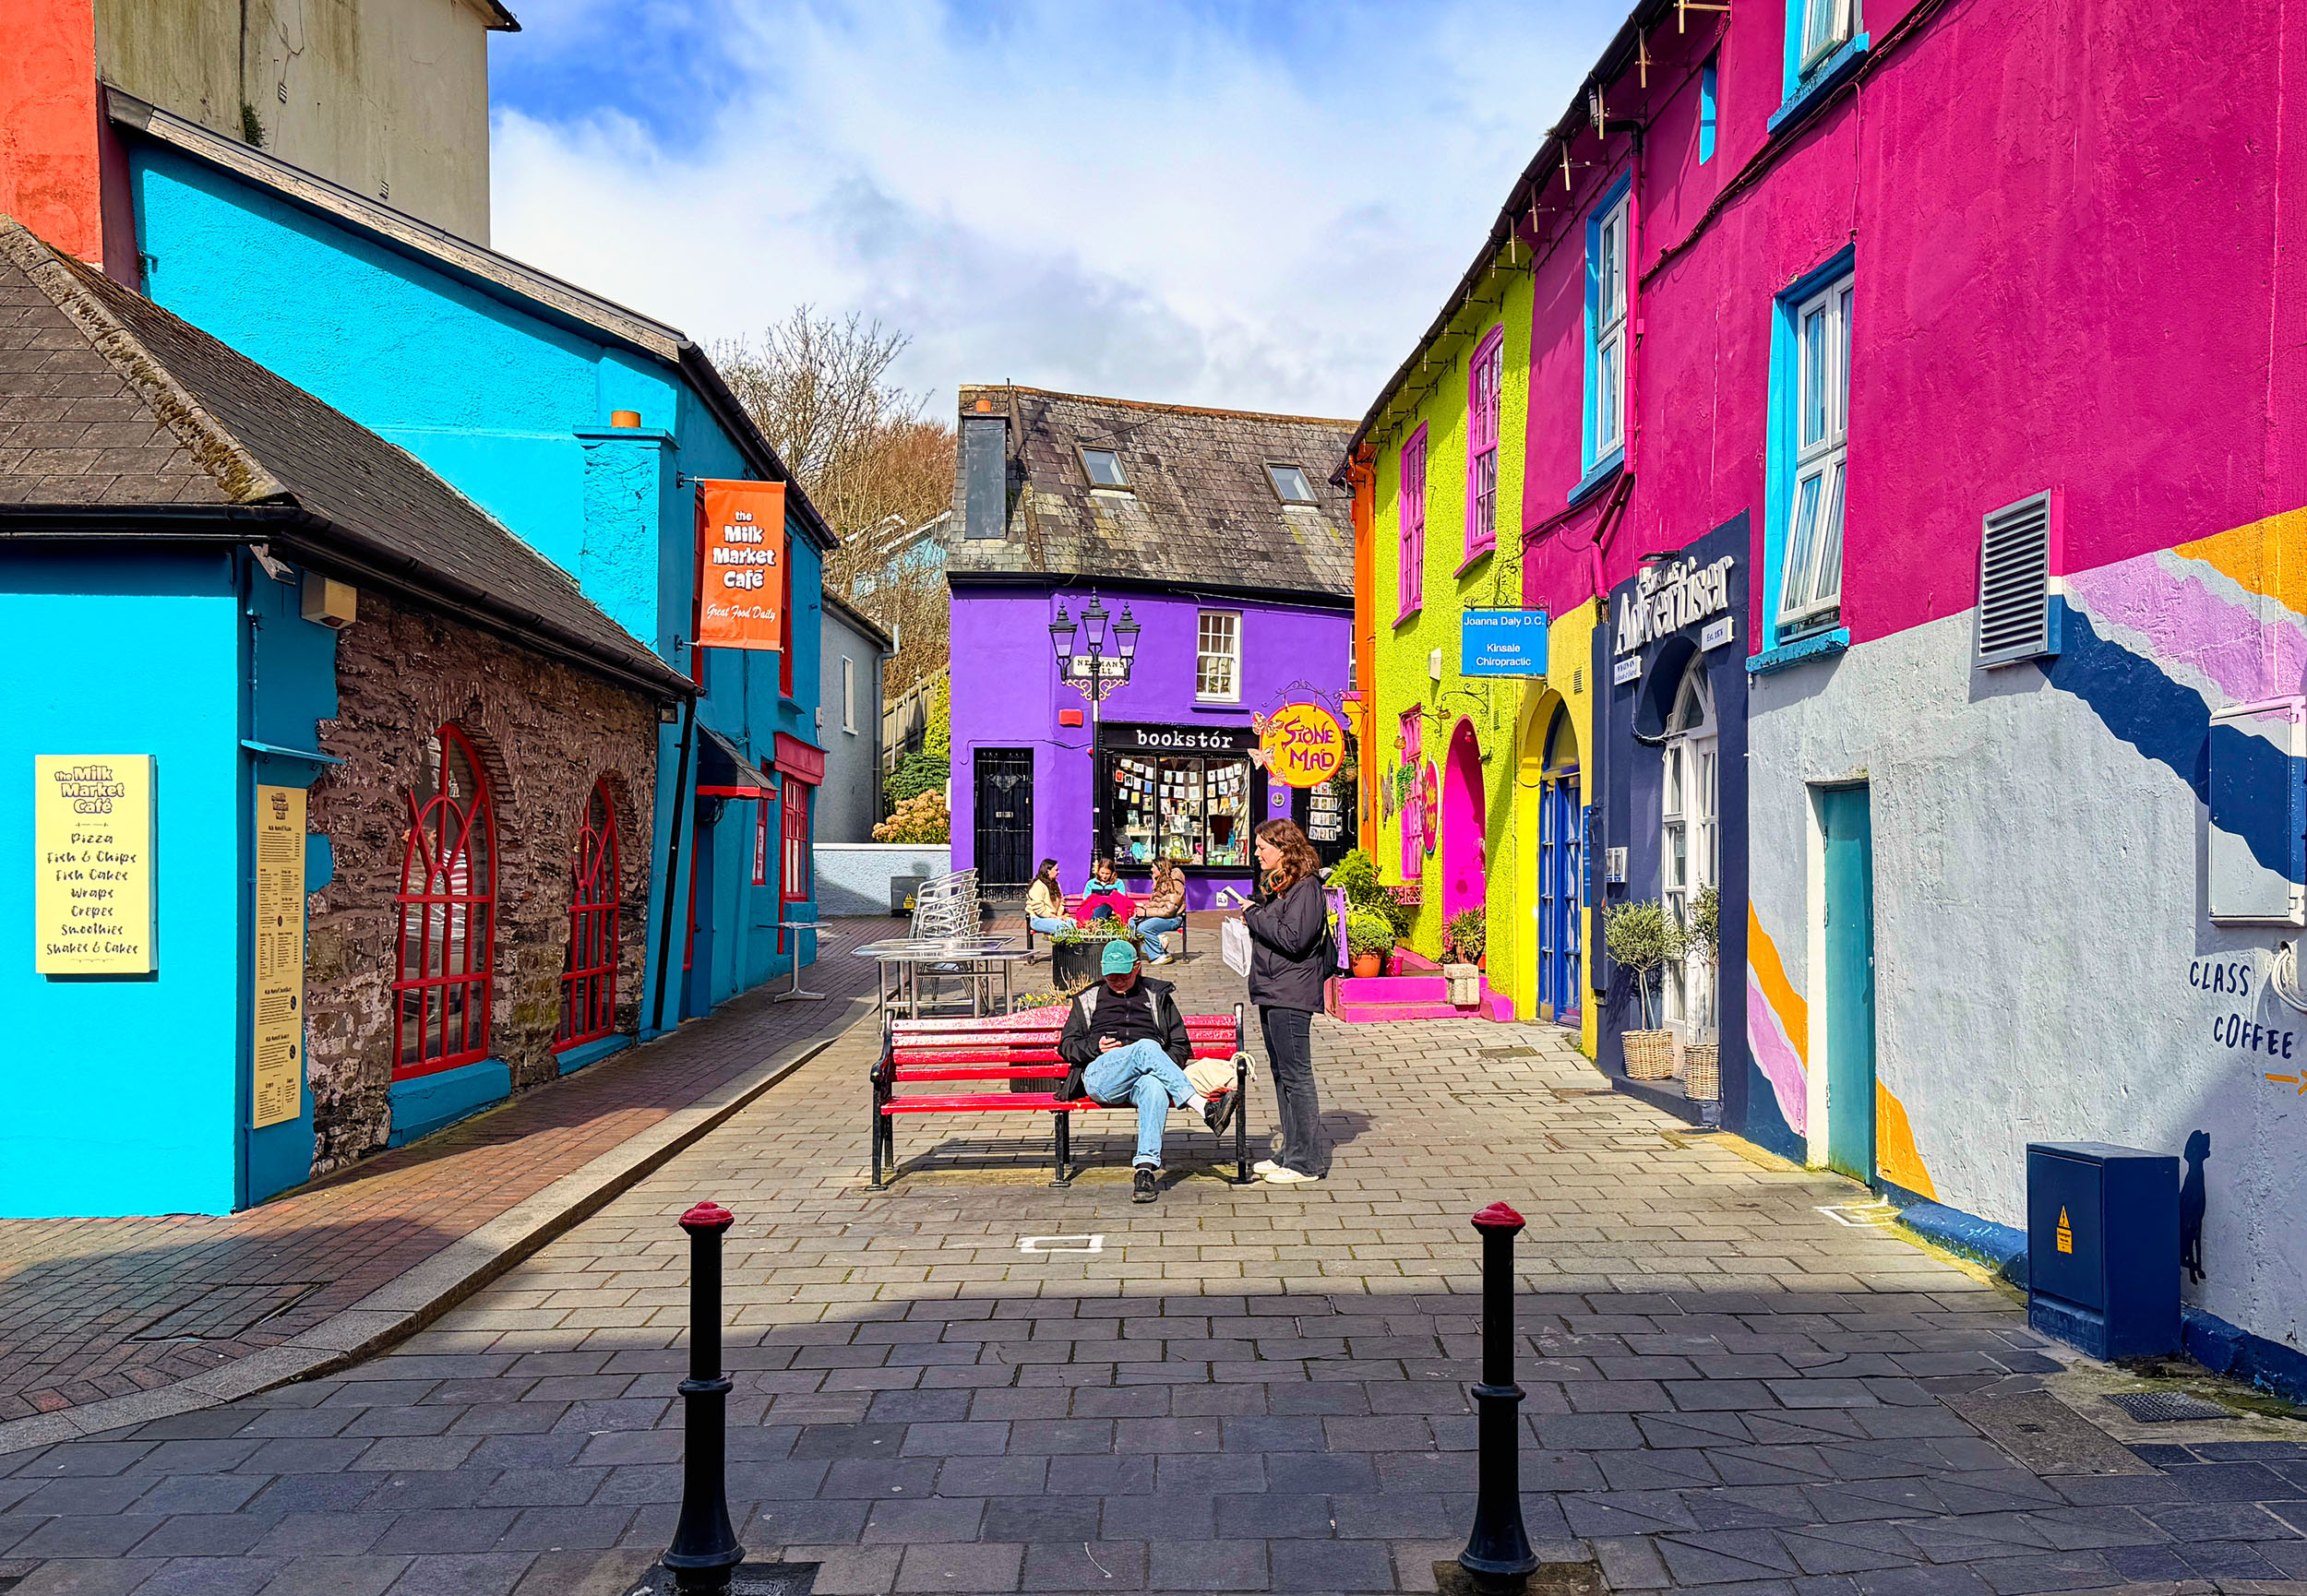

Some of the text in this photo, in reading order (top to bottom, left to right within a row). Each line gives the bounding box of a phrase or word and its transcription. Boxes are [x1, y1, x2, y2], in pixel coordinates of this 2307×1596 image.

[735, 511, 753, 522] the
[723, 524, 765, 544] Milk
[712, 547, 776, 566] Market
[723, 569, 765, 591] Café
[1613, 555, 1735, 656] Advertiser
[707, 604, 776, 623] Great Food Daily
[1464, 616, 1545, 627] Joanna Daly D.C.
[1487, 644, 1521, 652] Kinsale
[1476, 657, 1532, 667] Chiropractic
[1136, 729, 1233, 748] bookstór
[1289, 747, 1335, 771] MAD
[54, 765, 113, 781] the Milk
[61, 782, 125, 797] Market
[74, 798, 112, 813] Café
[71, 832, 114, 844] Pizza
[47, 851, 137, 865] Fish & Chips
[55, 869, 128, 881] Fish Cakes
[70, 887, 114, 900] Wraps
[71, 905, 114, 918] Crepes
[61, 923, 124, 935] Smoothies
[46, 941, 138, 956] Shakes & Cakes
[2190, 961, 2251, 996] CLASS
[2213, 1013, 2294, 1059] COFFEE
